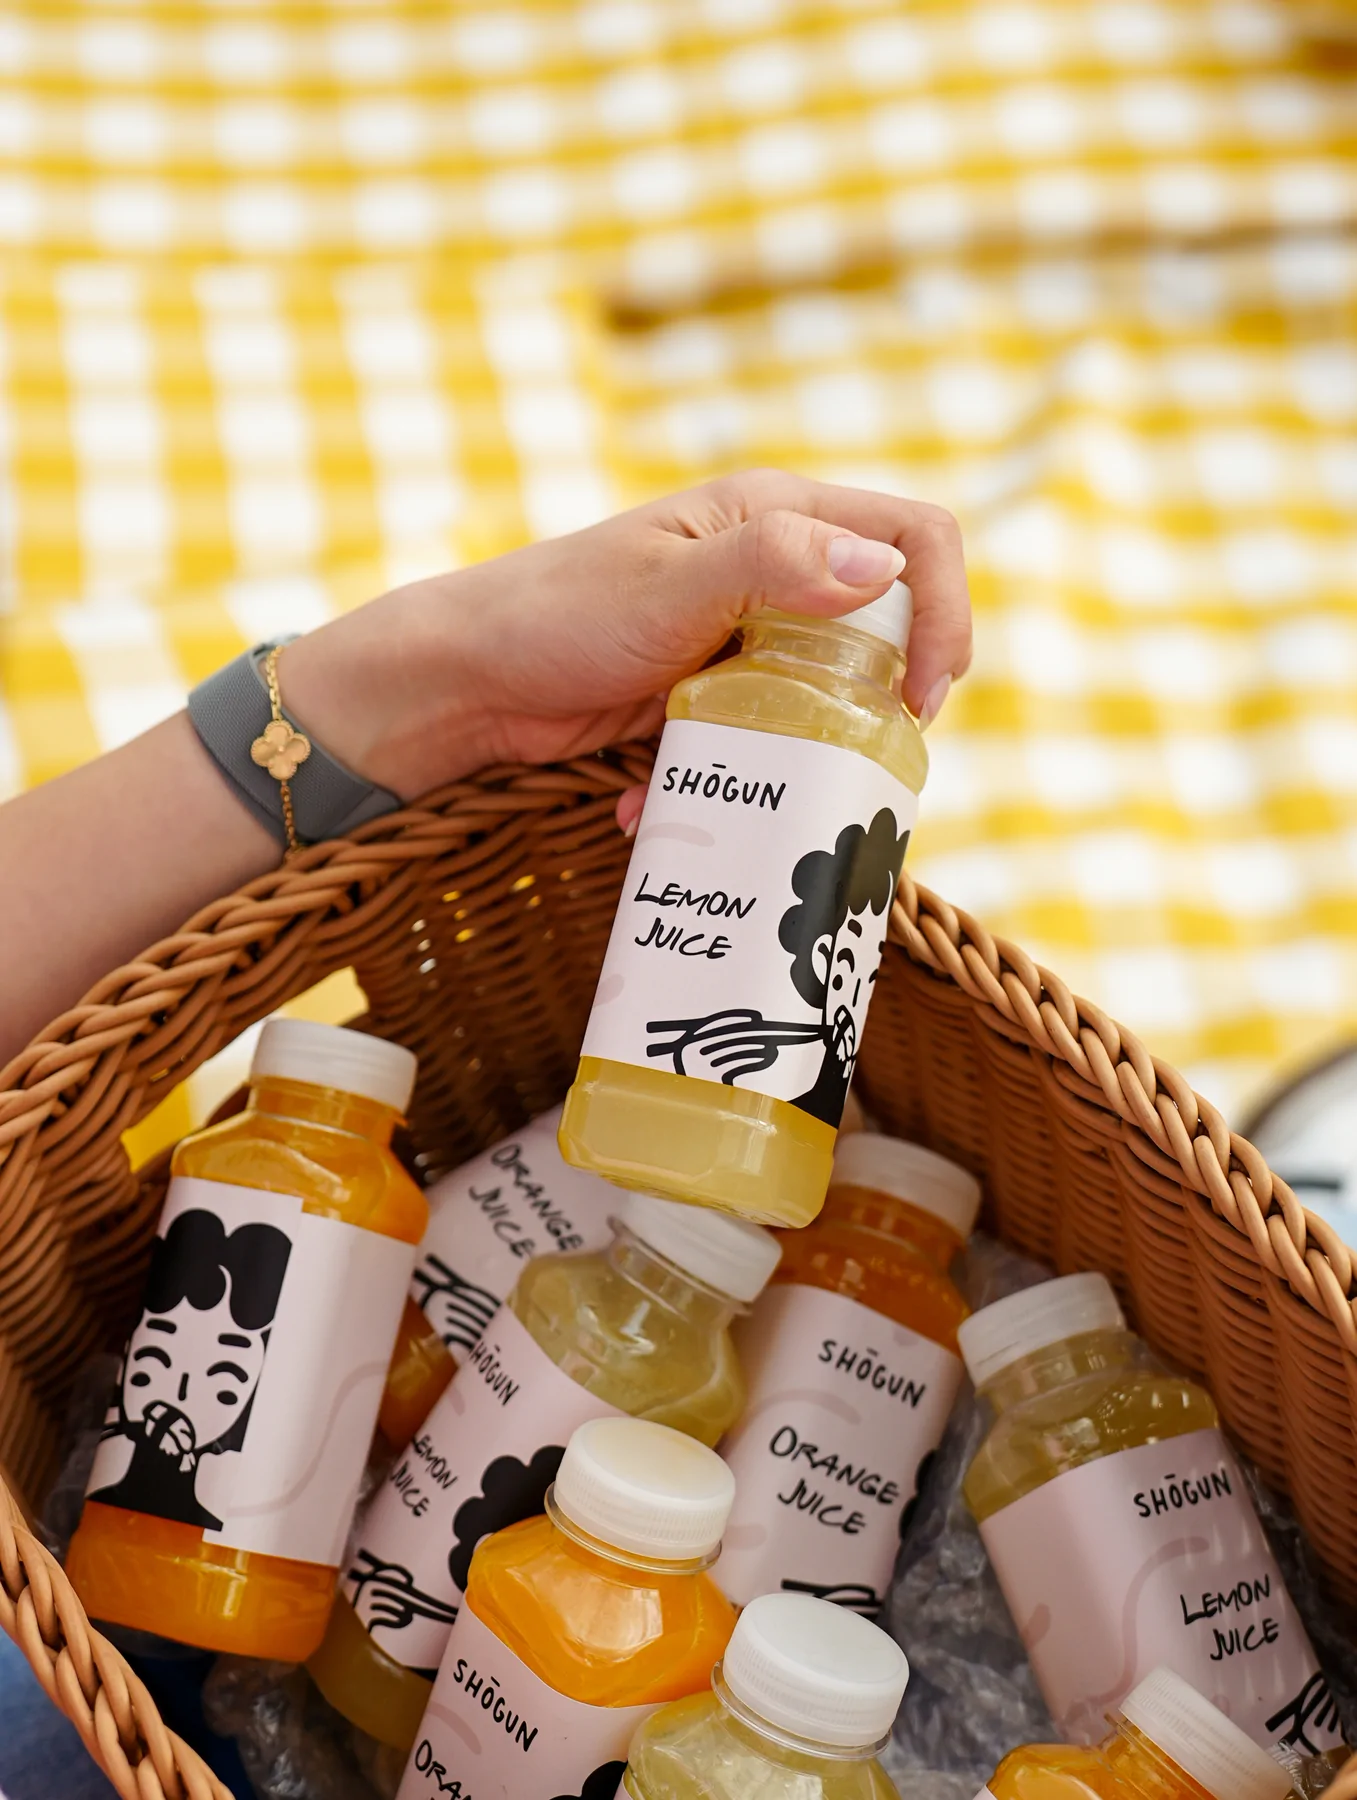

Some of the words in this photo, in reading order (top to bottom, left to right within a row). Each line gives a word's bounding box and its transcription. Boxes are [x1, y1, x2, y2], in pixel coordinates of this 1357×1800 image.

[663, 764, 786, 810] SHŌGUN
[634, 873, 756, 919] LEMON
[634, 917, 732, 959] JUICE
[469, 1186, 535, 1257] JUICE
[491, 1143, 583, 1251] ORANGE
[469, 1341, 519, 1406] HŌGUN
[818, 1340, 926, 1408] SHŌGUN
[769, 1426, 900, 1504] ORANGE
[1133, 1468, 1232, 1517] SHŌGUN
[777, 1478, 866, 1534] JUICE
[1180, 1574, 1271, 1625] LEMON
[1210, 1618, 1280, 1660] JUICE
[453, 1658, 538, 1752] SHŌGUN
[415, 1739, 471, 1800] ORA
